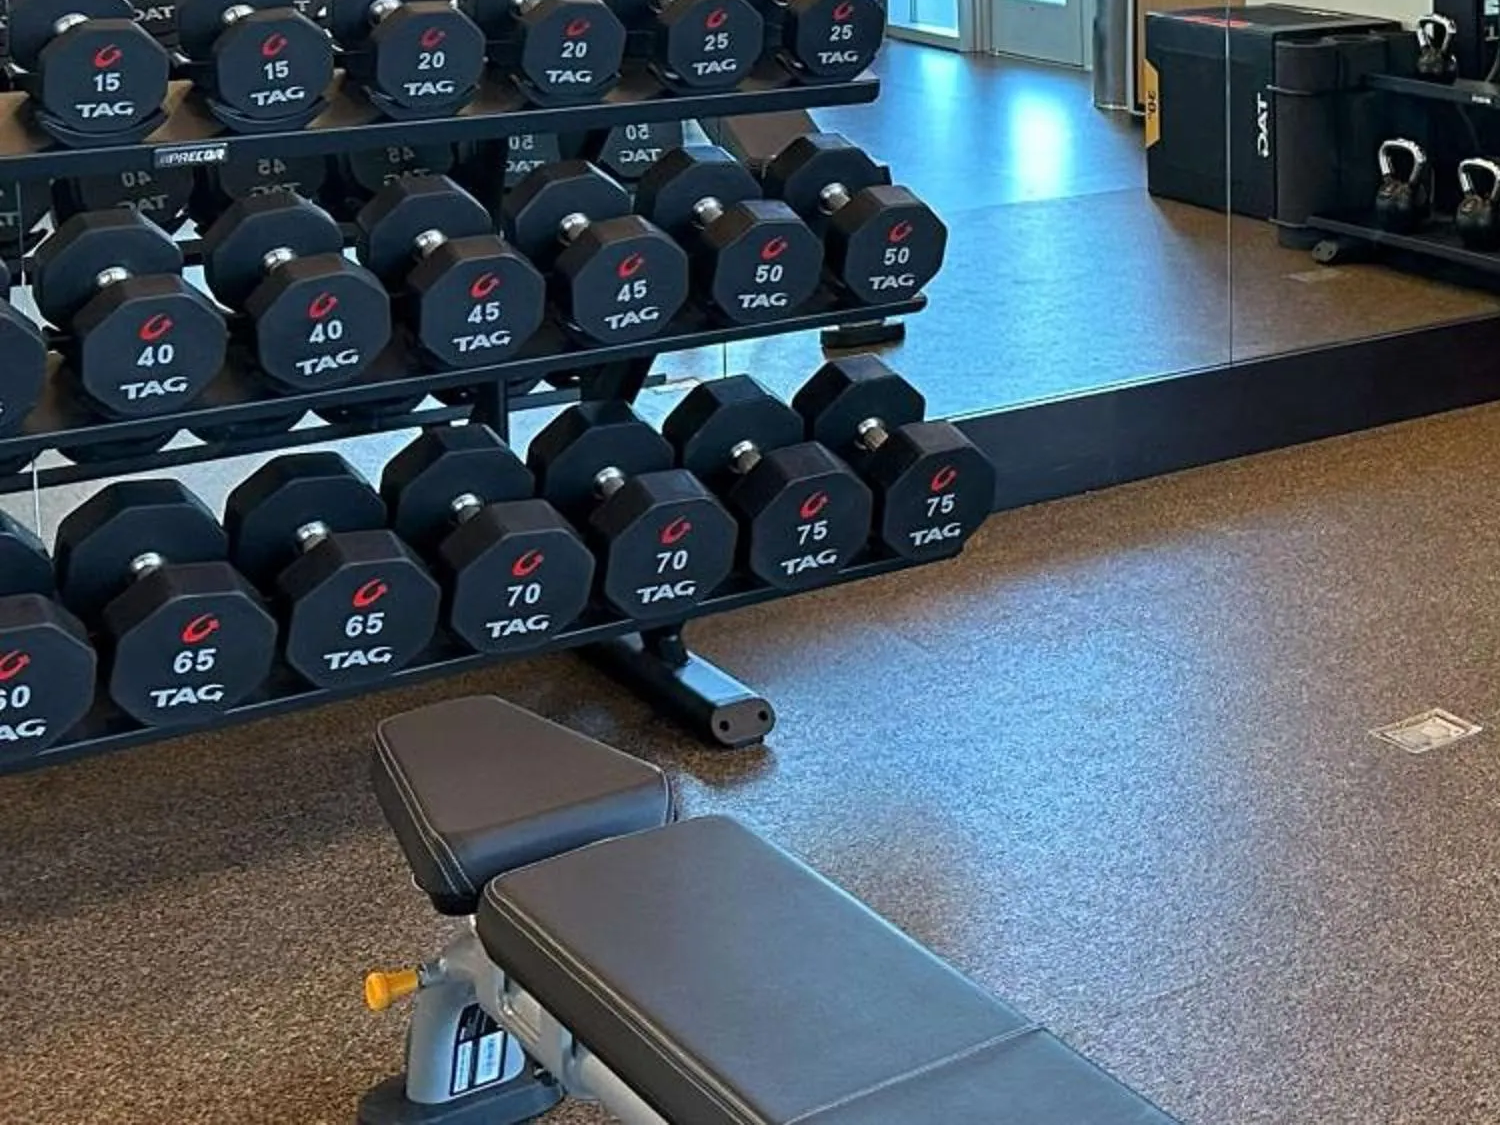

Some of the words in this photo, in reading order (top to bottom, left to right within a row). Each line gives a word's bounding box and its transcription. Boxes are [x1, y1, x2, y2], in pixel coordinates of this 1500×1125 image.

[704, 33, 728, 51] 25
[830, 25, 852, 41] 25
[562, 42, 587, 57] 20
[818, 51, 858, 64] TAG
[265, 61, 288, 79] 15
[418, 52, 444, 69] 20
[693, 59, 736, 75] TAG
[95, 73, 120, 91] 15
[546, 70, 591, 82] TAG
[251, 87, 304, 105] TAG
[404, 81, 453, 95] TAG
[76, 102, 133, 117] TAG
[884, 247, 909, 265] 50
[756, 265, 783, 283] 50
[869, 274, 914, 289] TAG
[617, 280, 646, 301] 45
[739, 293, 787, 308] TAG
[468, 302, 499, 323] 45
[605, 307, 659, 329] TAG
[310, 320, 342, 342] 40
[453, 331, 510, 351] TAG
[137, 345, 173, 366] 40
[296, 349, 358, 375] TAG
[120, 377, 187, 399] TAG
[927, 494, 955, 516] 75
[798, 520, 827, 544] 75
[910, 523, 960, 545] TAG
[657, 550, 688, 573] 70
[781, 550, 837, 574] TAG
[508, 583, 540, 606] 70
[637, 581, 695, 603] TAG
[346, 613, 384, 637] 65
[486, 615, 548, 637] TAG
[174, 648, 216, 673] 65
[324, 647, 391, 669] TAG
[150, 684, 223, 707] TAG
[0, 718, 47, 742] AG
